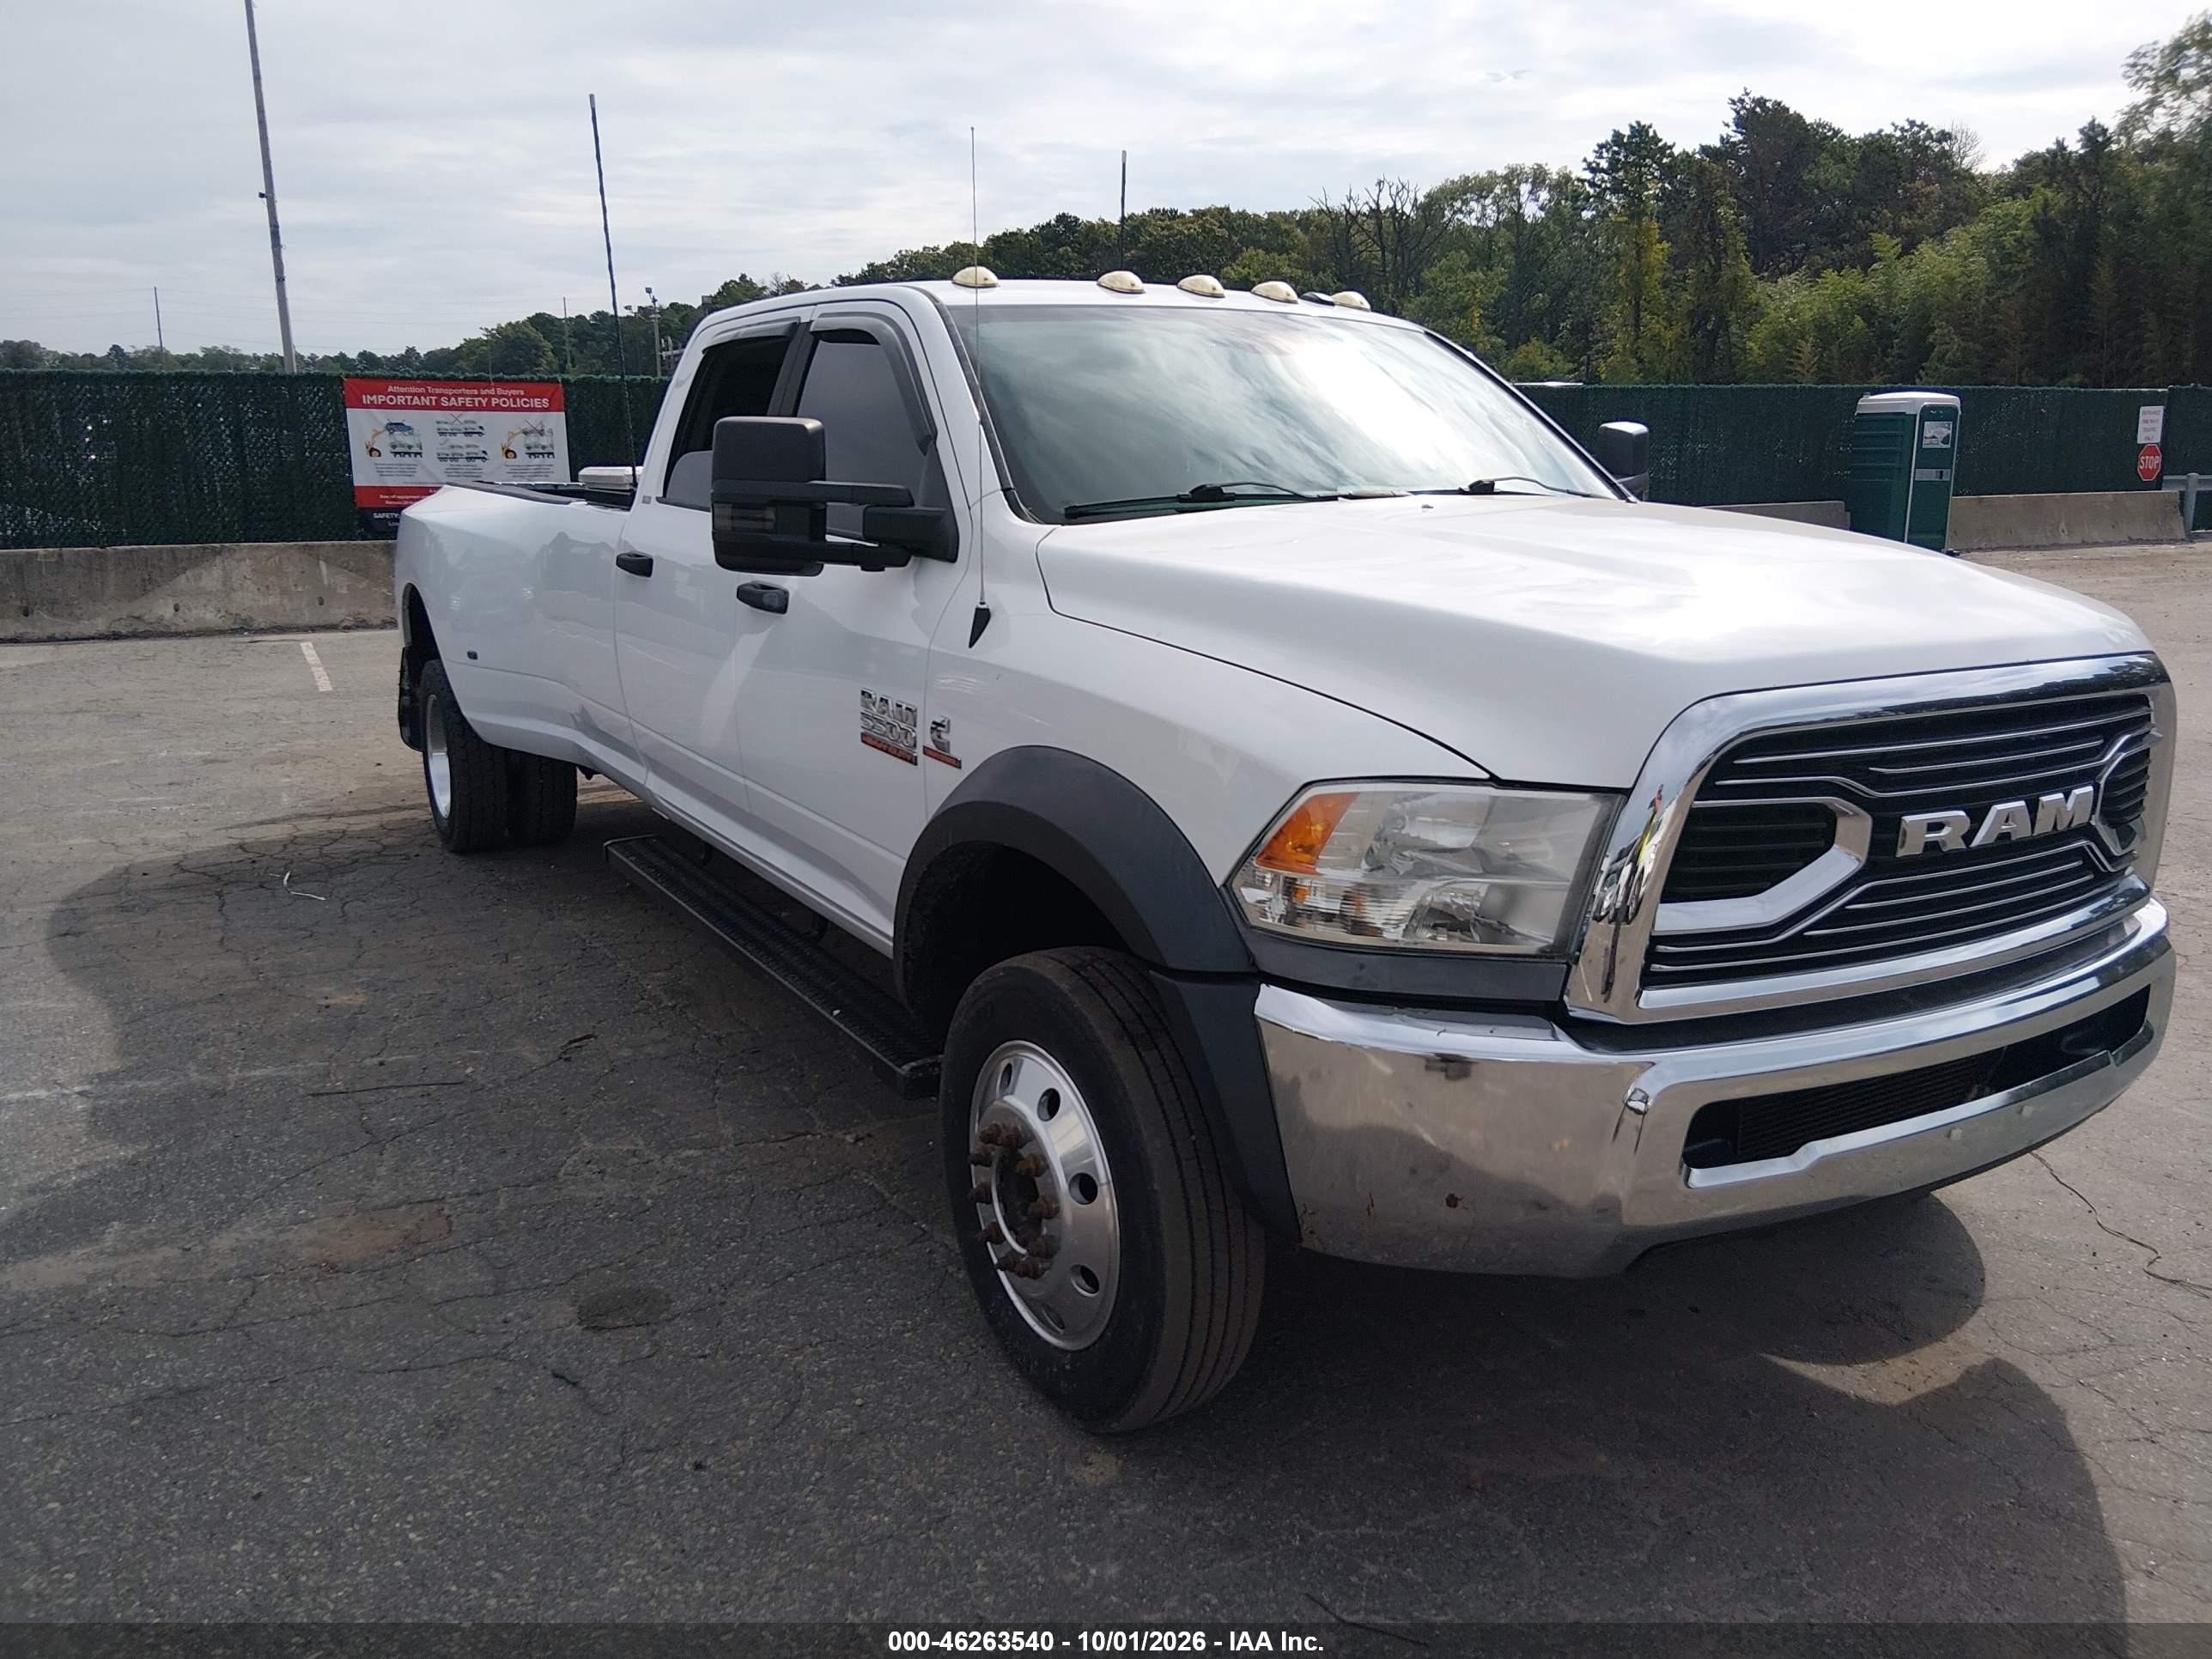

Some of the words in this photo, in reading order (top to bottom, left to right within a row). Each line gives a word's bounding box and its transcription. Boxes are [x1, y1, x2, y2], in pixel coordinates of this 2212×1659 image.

[362, 394, 437, 406] IMPORTANT
[440, 396, 488, 408] SAFETY
[491, 397, 550, 409] POLICIES
[387, 386, 425, 394] Attention
[428, 386, 478, 396] Transporters
[496, 388, 525, 397] Buyers
[2139, 455, 2160, 469] STOP
[860, 687, 917, 727] RAM
[860, 709, 917, 750] 5500
[1895, 786, 2094, 858] RAM
